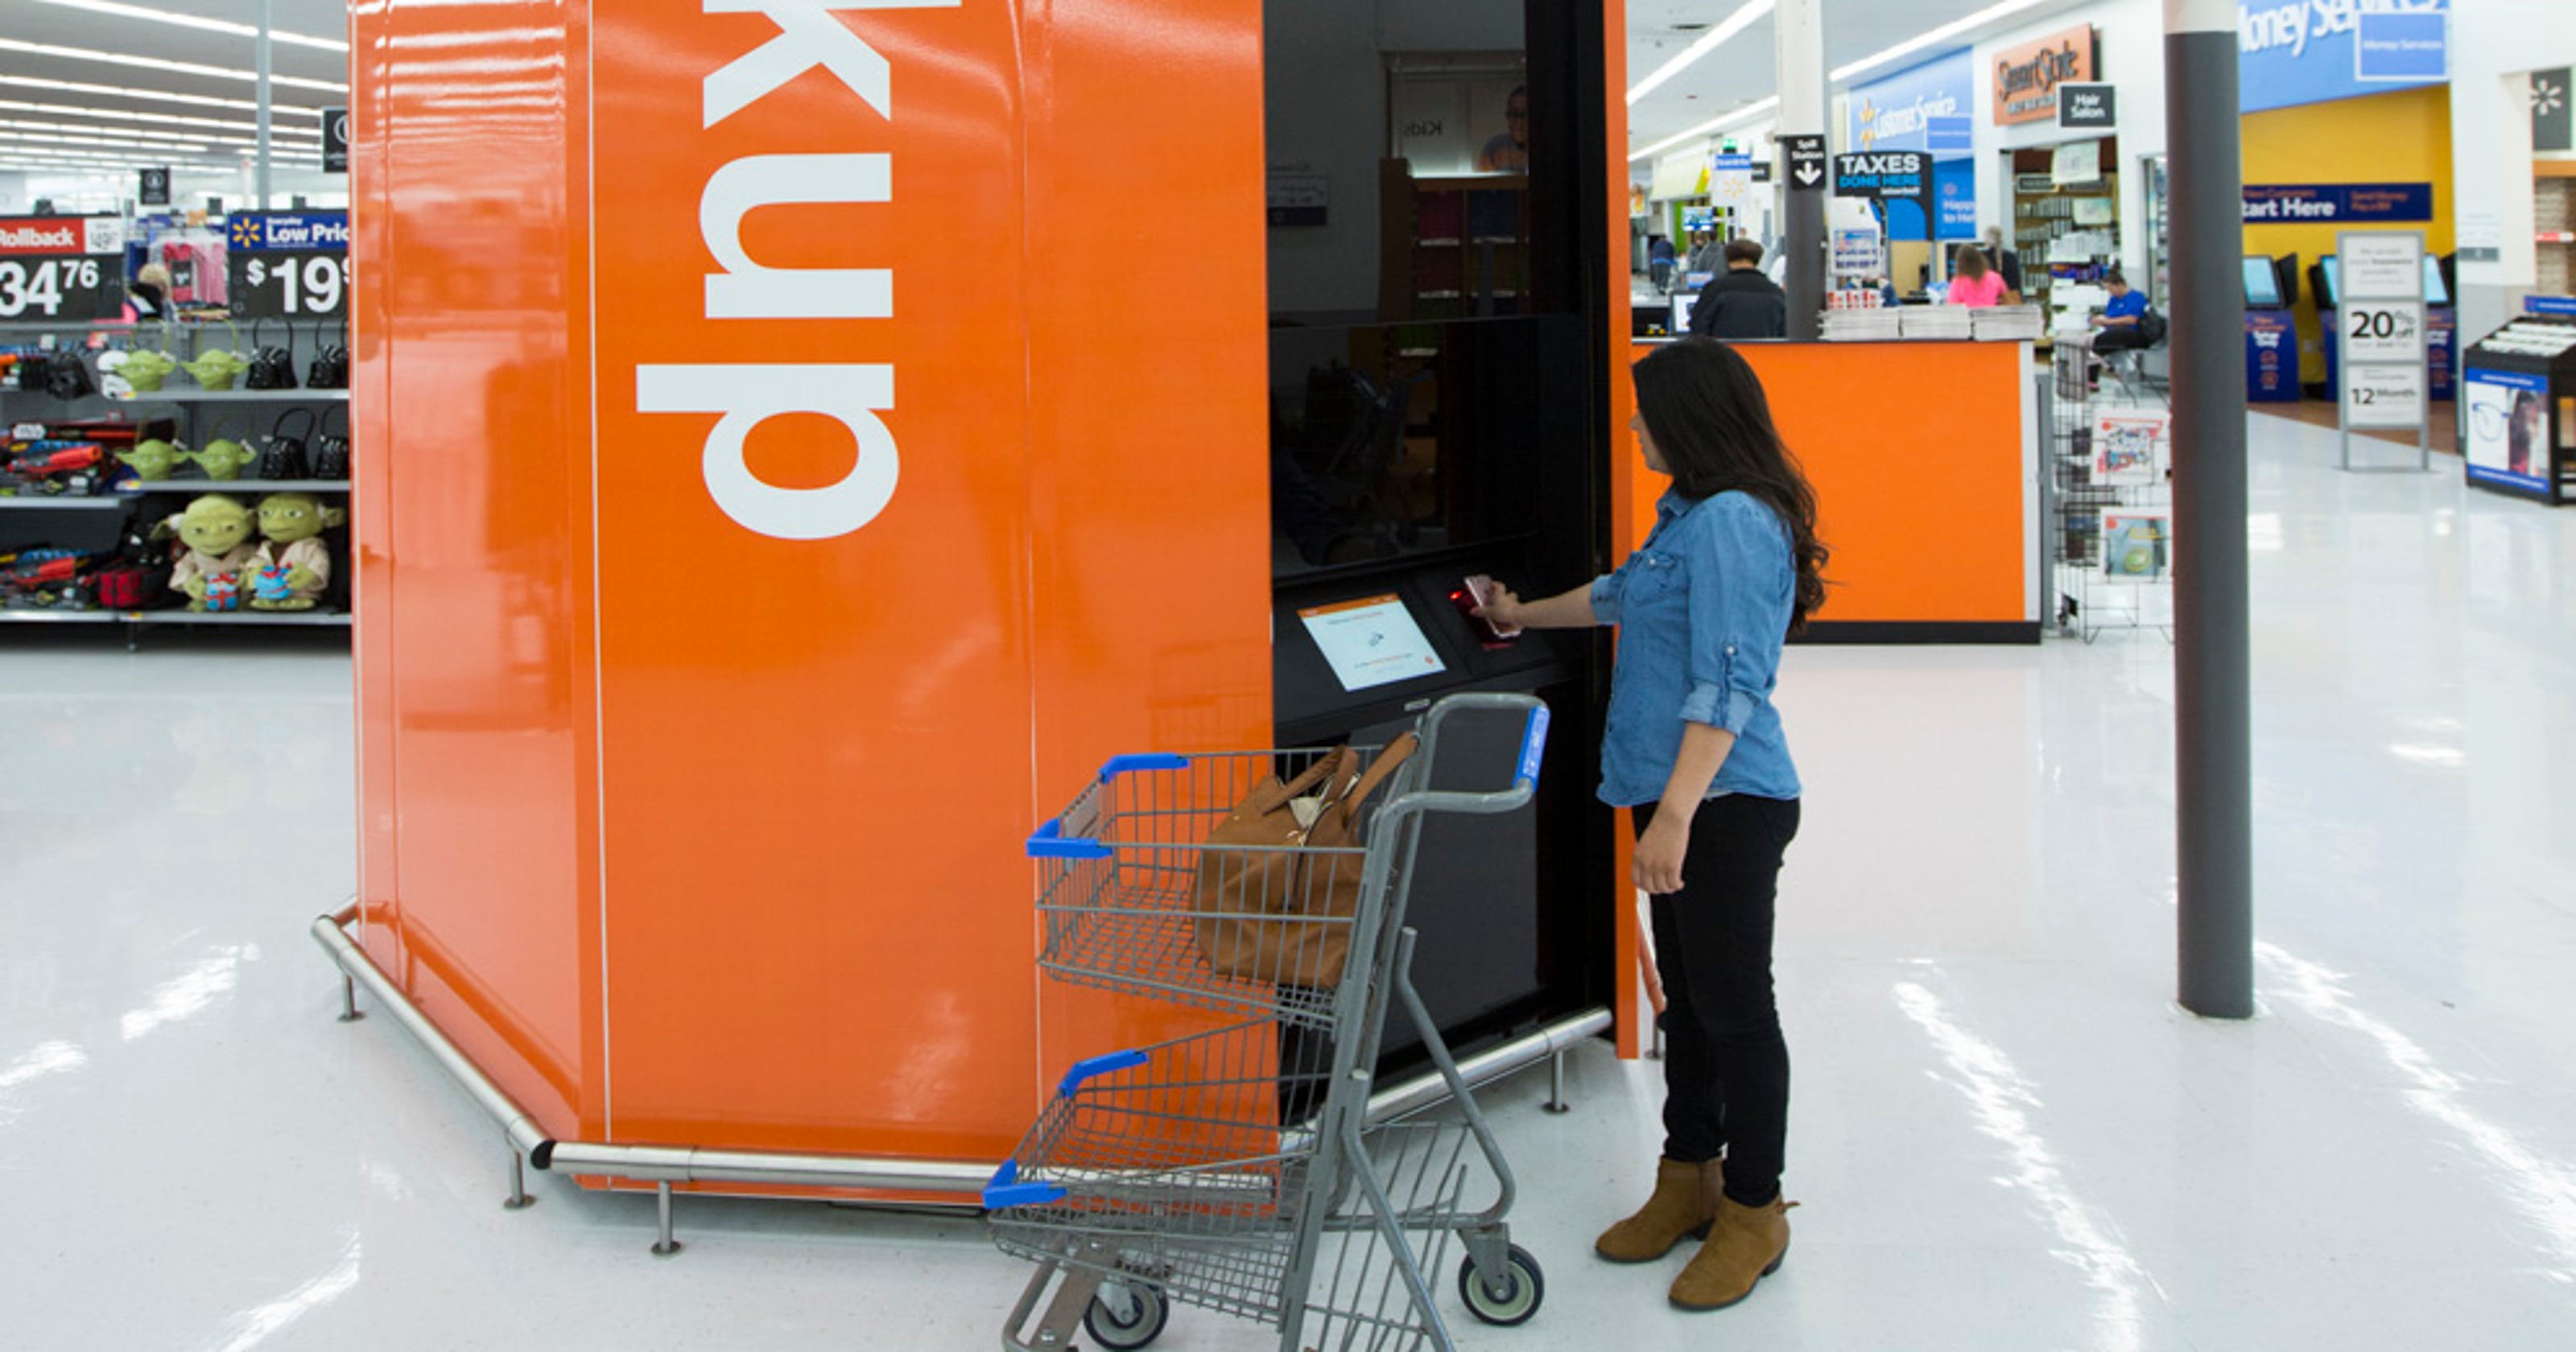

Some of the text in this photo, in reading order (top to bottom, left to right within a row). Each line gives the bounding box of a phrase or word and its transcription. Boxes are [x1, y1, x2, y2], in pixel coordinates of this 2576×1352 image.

[2074, 93, 2101, 105] Hair
[2070, 106, 2105, 118] Salon
[1797, 139, 1818, 149] Spill
[1791, 151, 1824, 160] Station
[1839, 154, 1920, 175] TAXES
[1839, 174, 1922, 188] DONE HERE
[2282, 198, 2336, 216] Here
[266, 224, 308, 242] Low
[2351, 311, 2394, 338] 20
[2351, 388, 2376, 405] 12
